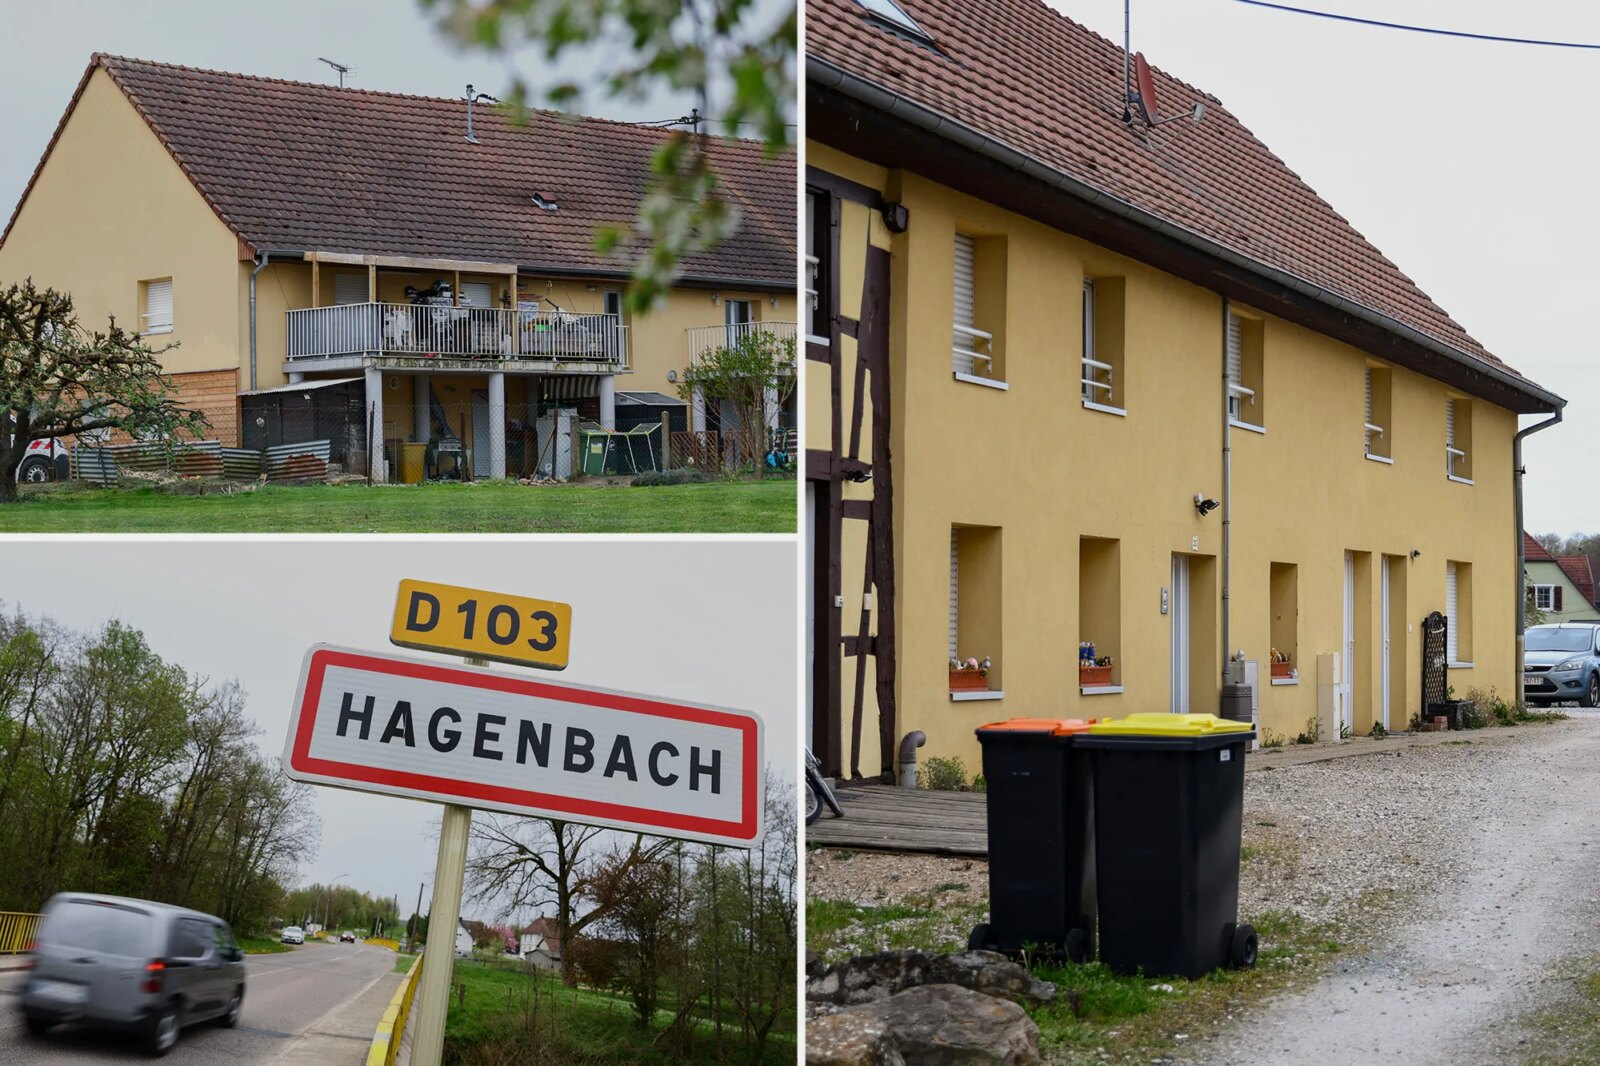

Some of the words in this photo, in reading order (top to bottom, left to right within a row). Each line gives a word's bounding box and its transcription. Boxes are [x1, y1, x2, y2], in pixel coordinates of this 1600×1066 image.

[405, 590, 441, 633] D
[456, 599, 559, 652] 103
[335, 691, 722, 795] HAGENBACH
